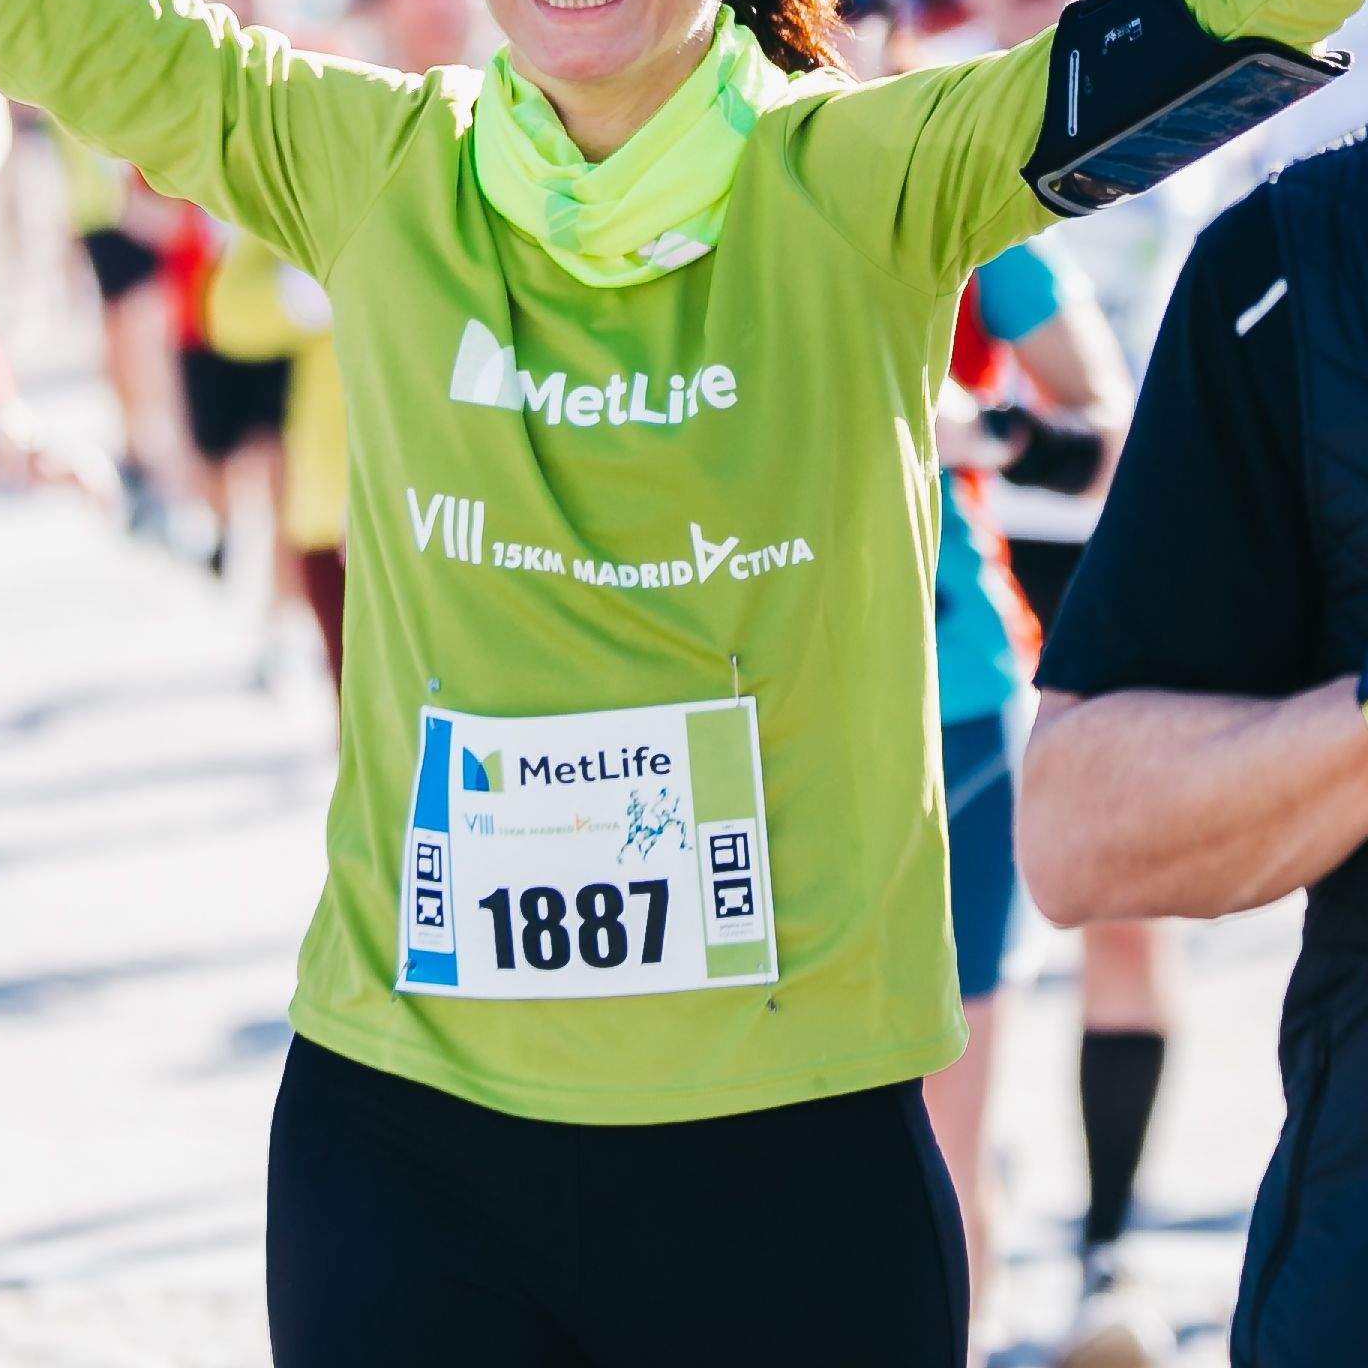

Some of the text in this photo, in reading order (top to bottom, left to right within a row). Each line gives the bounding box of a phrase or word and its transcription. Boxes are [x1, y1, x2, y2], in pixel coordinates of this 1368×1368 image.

[515, 363, 739, 427] MetLife
[406, 486, 485, 565] VIII
[491, 540, 567, 575] 15KM
[518, 745, 673, 786] MetLife
[463, 812, 495, 835] VIII
[477, 878, 670, 971] 1887
